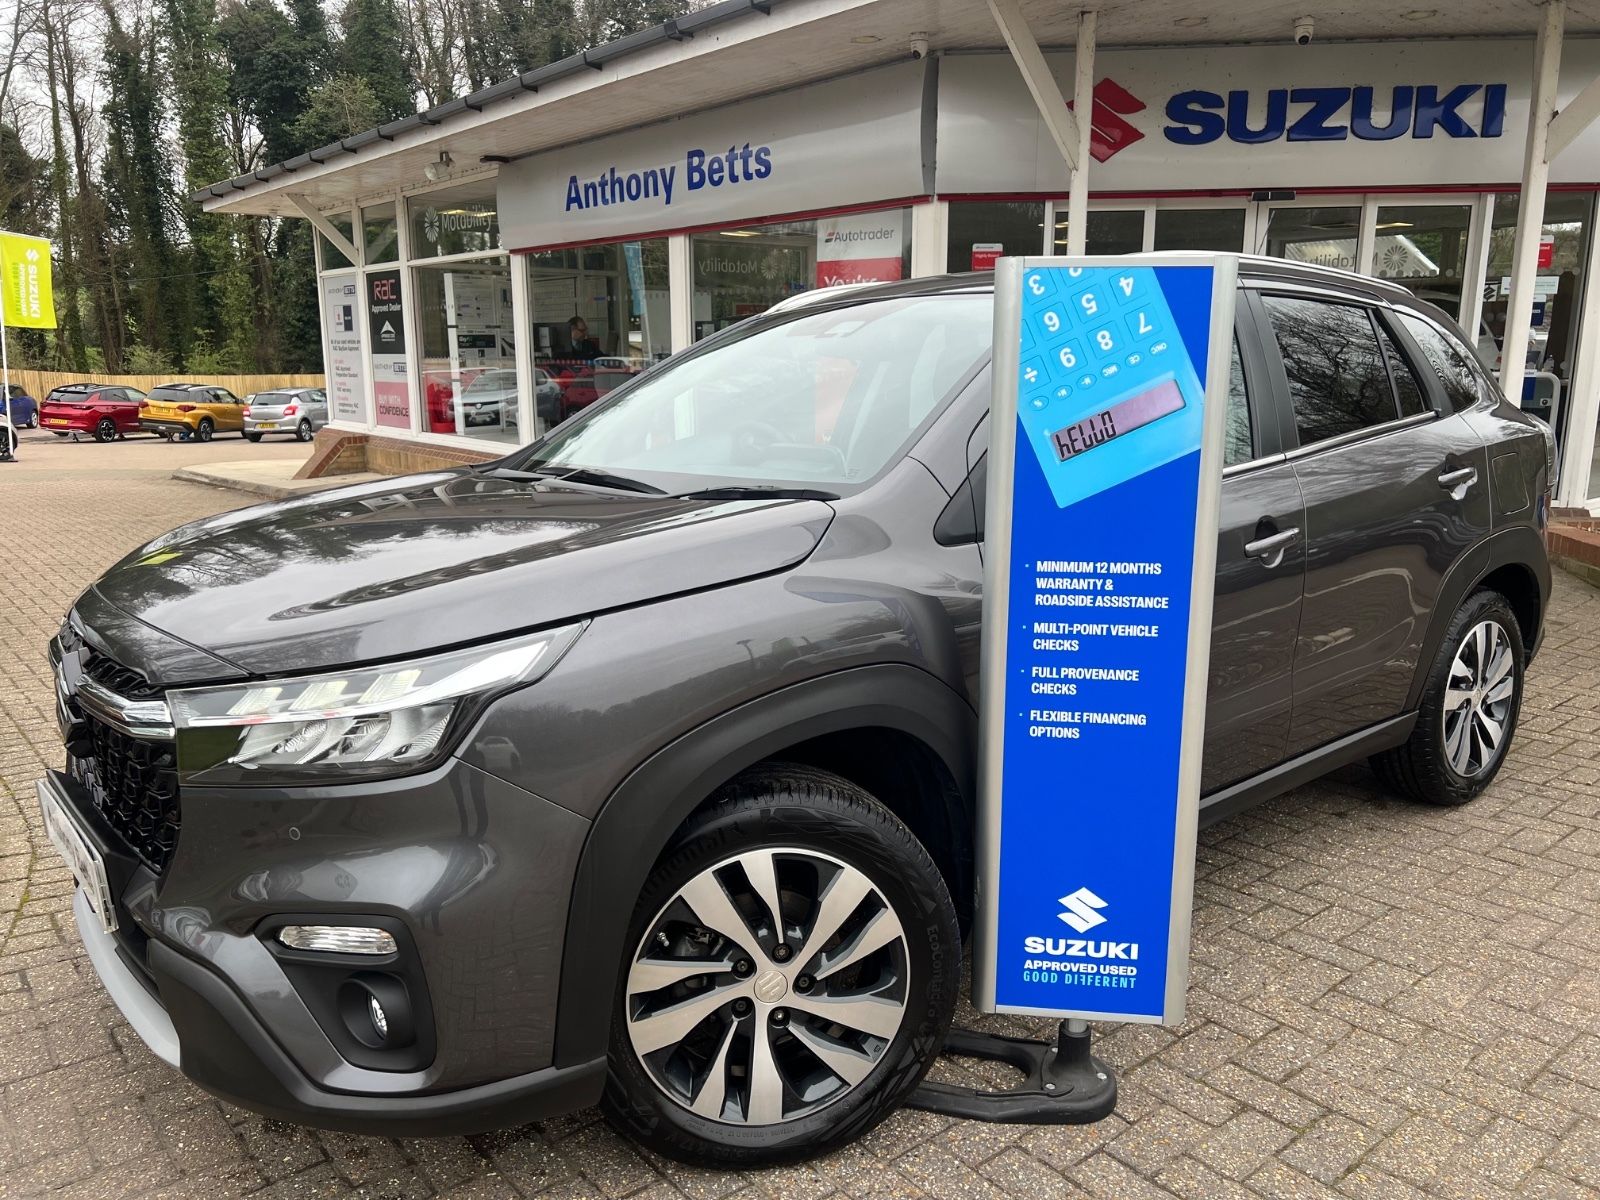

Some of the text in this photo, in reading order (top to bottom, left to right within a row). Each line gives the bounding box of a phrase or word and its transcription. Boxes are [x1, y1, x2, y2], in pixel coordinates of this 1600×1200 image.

[1163, 84, 1507, 145] SUZUKI
[565, 142, 772, 211] Anthony Betts
[834, 228, 894, 242] Autotrader
[28, 264, 41, 318] SUZUKI
[371, 302, 401, 314] Approved Dealer
[379, 405, 409, 417] CONFIDENCE
[1036, 561, 1162, 575] MINIMUM 12 MONTHS
[1036, 578, 1114, 591] WARRANTY &
[1035, 594, 1169, 609] ROADSIDE ASSISTANCE
[1033, 622, 1159, 637] MULTI-POINT VEHICLE
[1033, 638, 1079, 651] CHECKS
[1031, 666, 1140, 681] FULL PROVENANCE
[1031, 682, 1077, 695] CHECKS
[1030, 710, 1147, 726] FLEXIBLE FINANCING
[1029, 725, 1080, 739] OPTIONS
[1024, 936, 1139, 960] SUZUKI
[1024, 960, 1138, 976] APPROVED USED
[1023, 971, 1058, 984] GOOD
